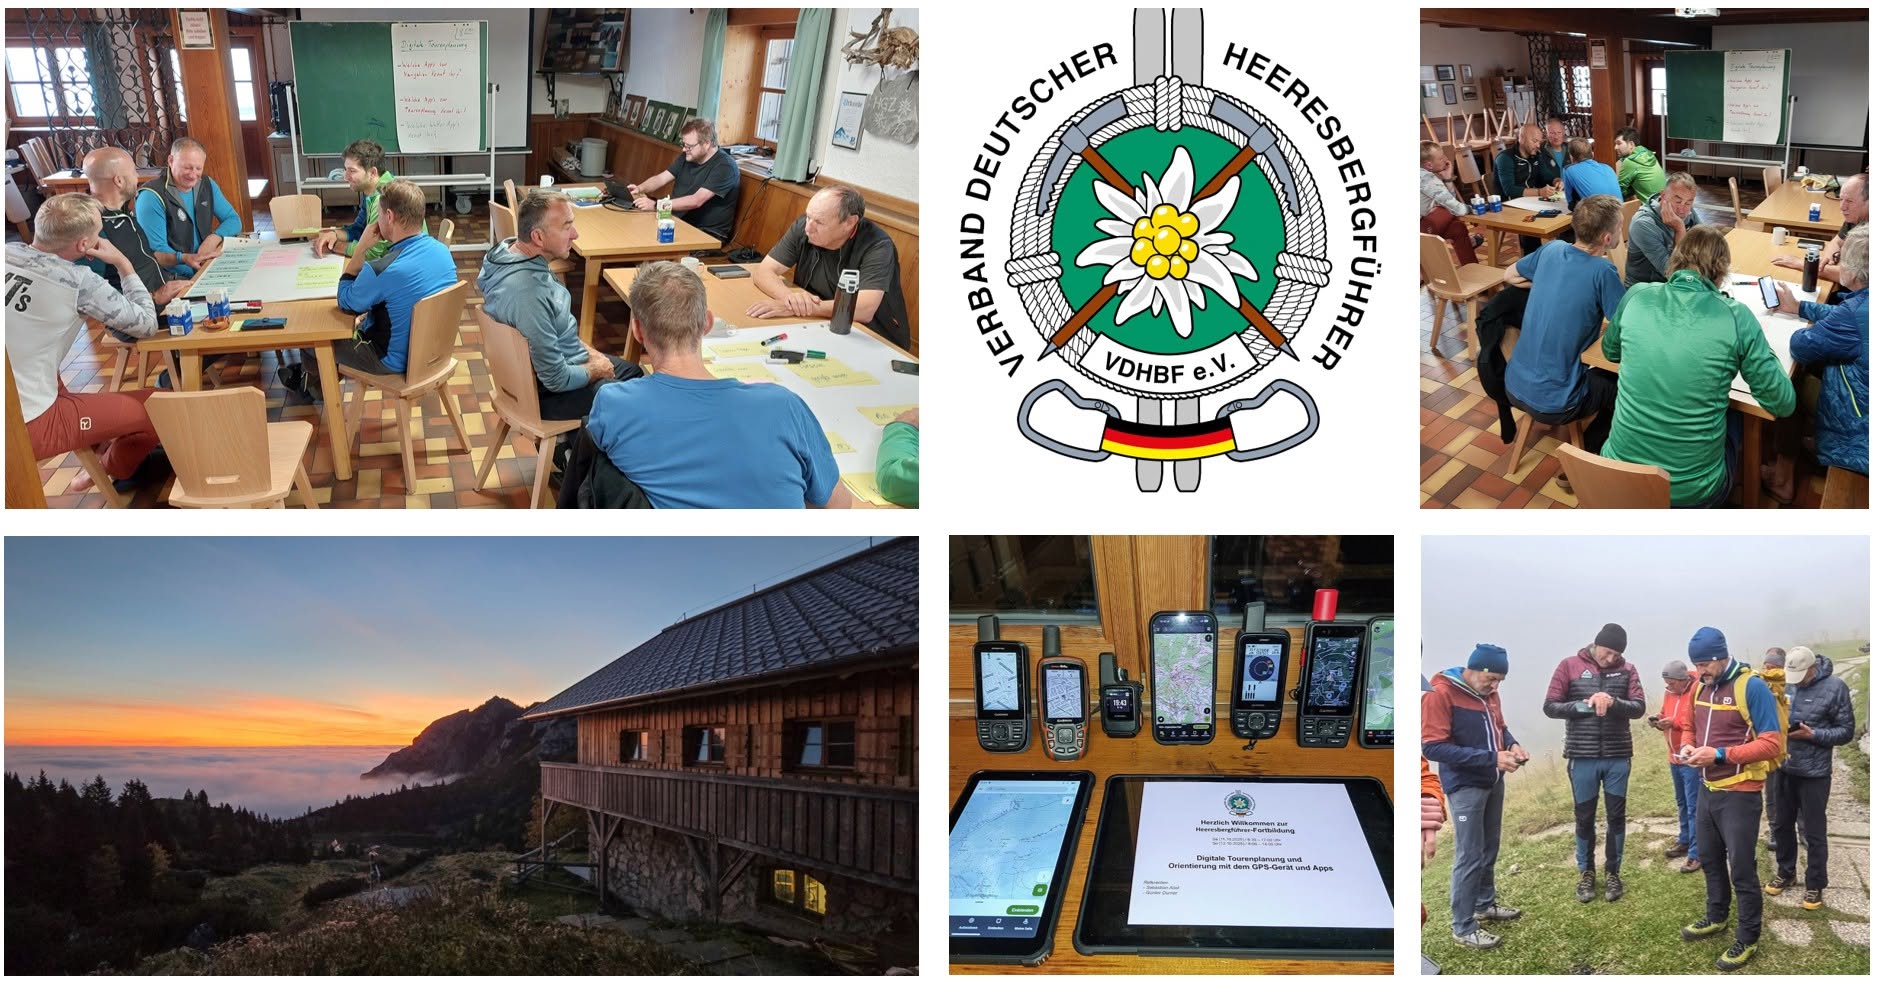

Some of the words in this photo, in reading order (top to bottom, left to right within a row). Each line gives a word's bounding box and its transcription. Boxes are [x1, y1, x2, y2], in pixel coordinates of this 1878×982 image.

[873, 97, 896, 112] HGZ
[966, 43, 1117, 201] DEUTSCHER
[1223, 43, 1382, 370] HEERESBERGFÜHRER
[5, 272, 33, 312] T's
[960, 214, 1024, 377] VERBAND
[1106, 352, 1184, 383] VDHBF
[1194, 353, 1235, 380] e.V.
